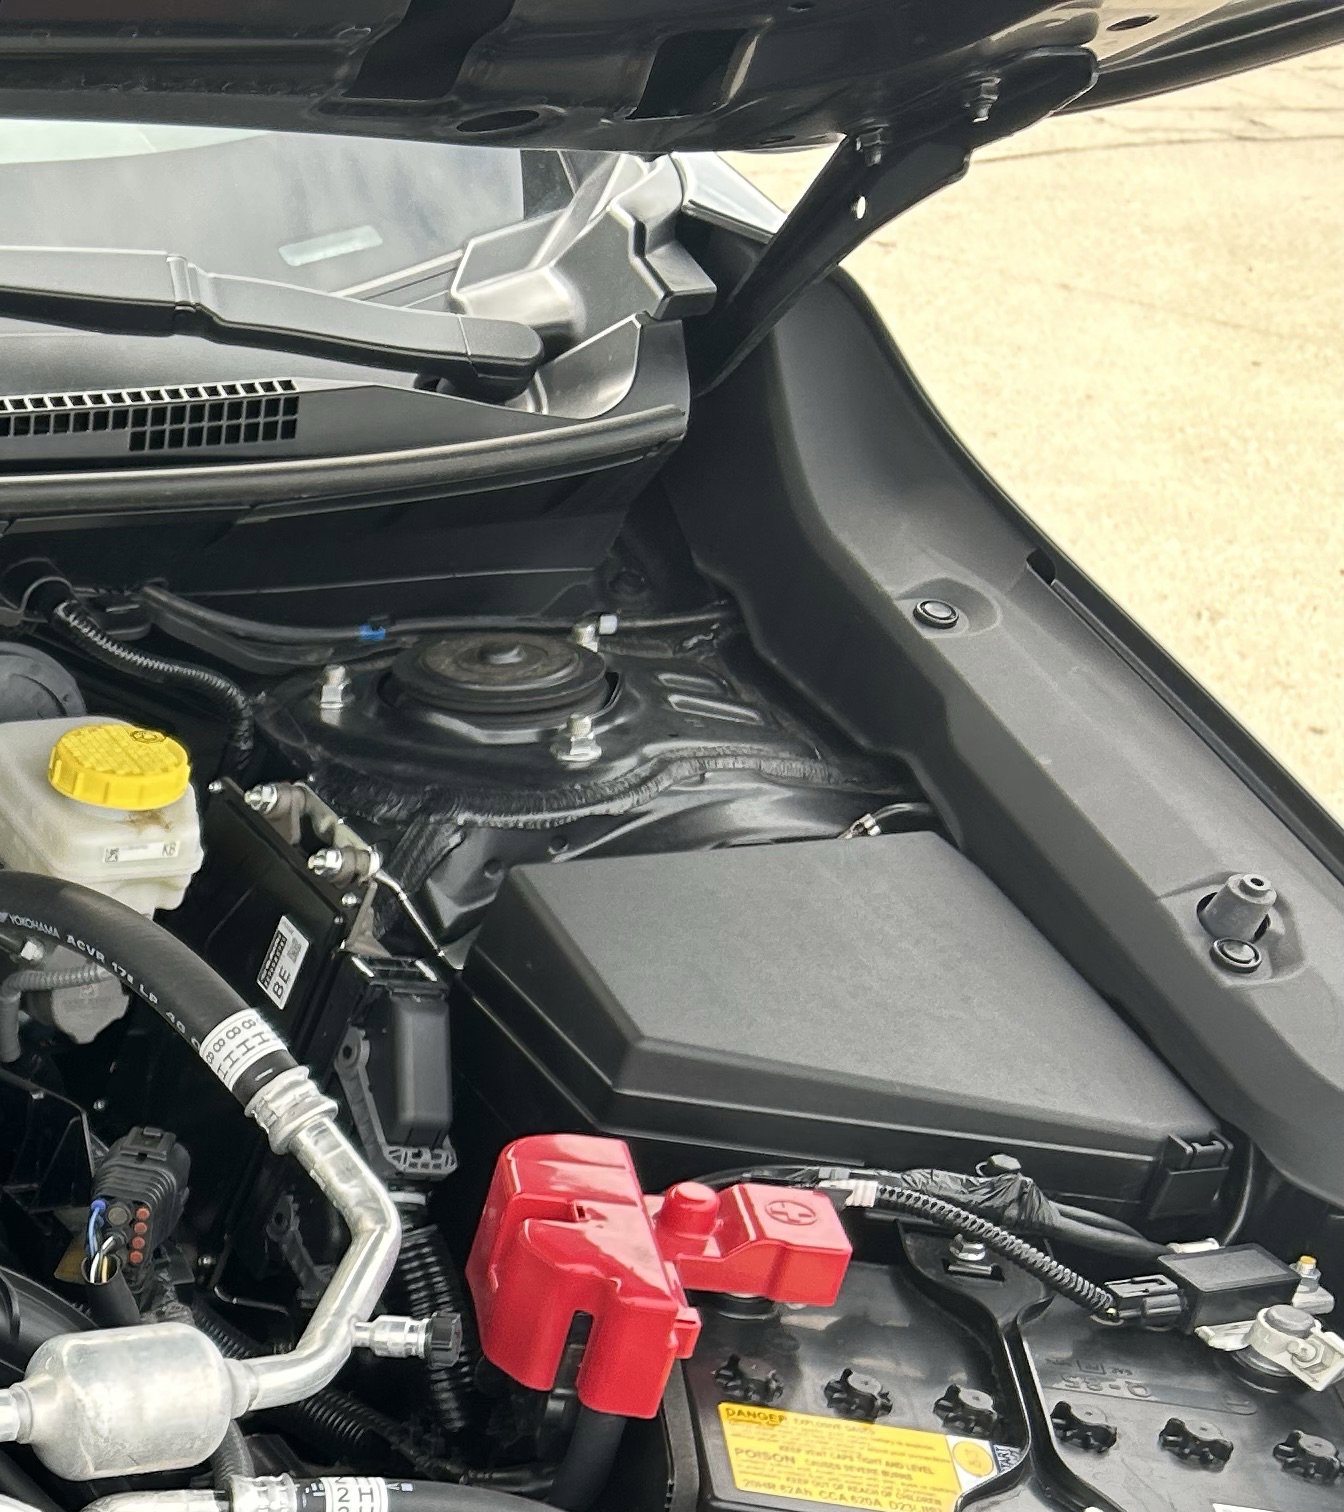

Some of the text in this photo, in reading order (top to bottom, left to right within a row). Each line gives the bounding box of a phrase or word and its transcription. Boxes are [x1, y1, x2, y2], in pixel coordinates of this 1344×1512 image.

[9, 914, 60, 938] YOKOHAMA
[66, 934, 106, 964] ACVR
[272, 964, 292, 1000] BE
